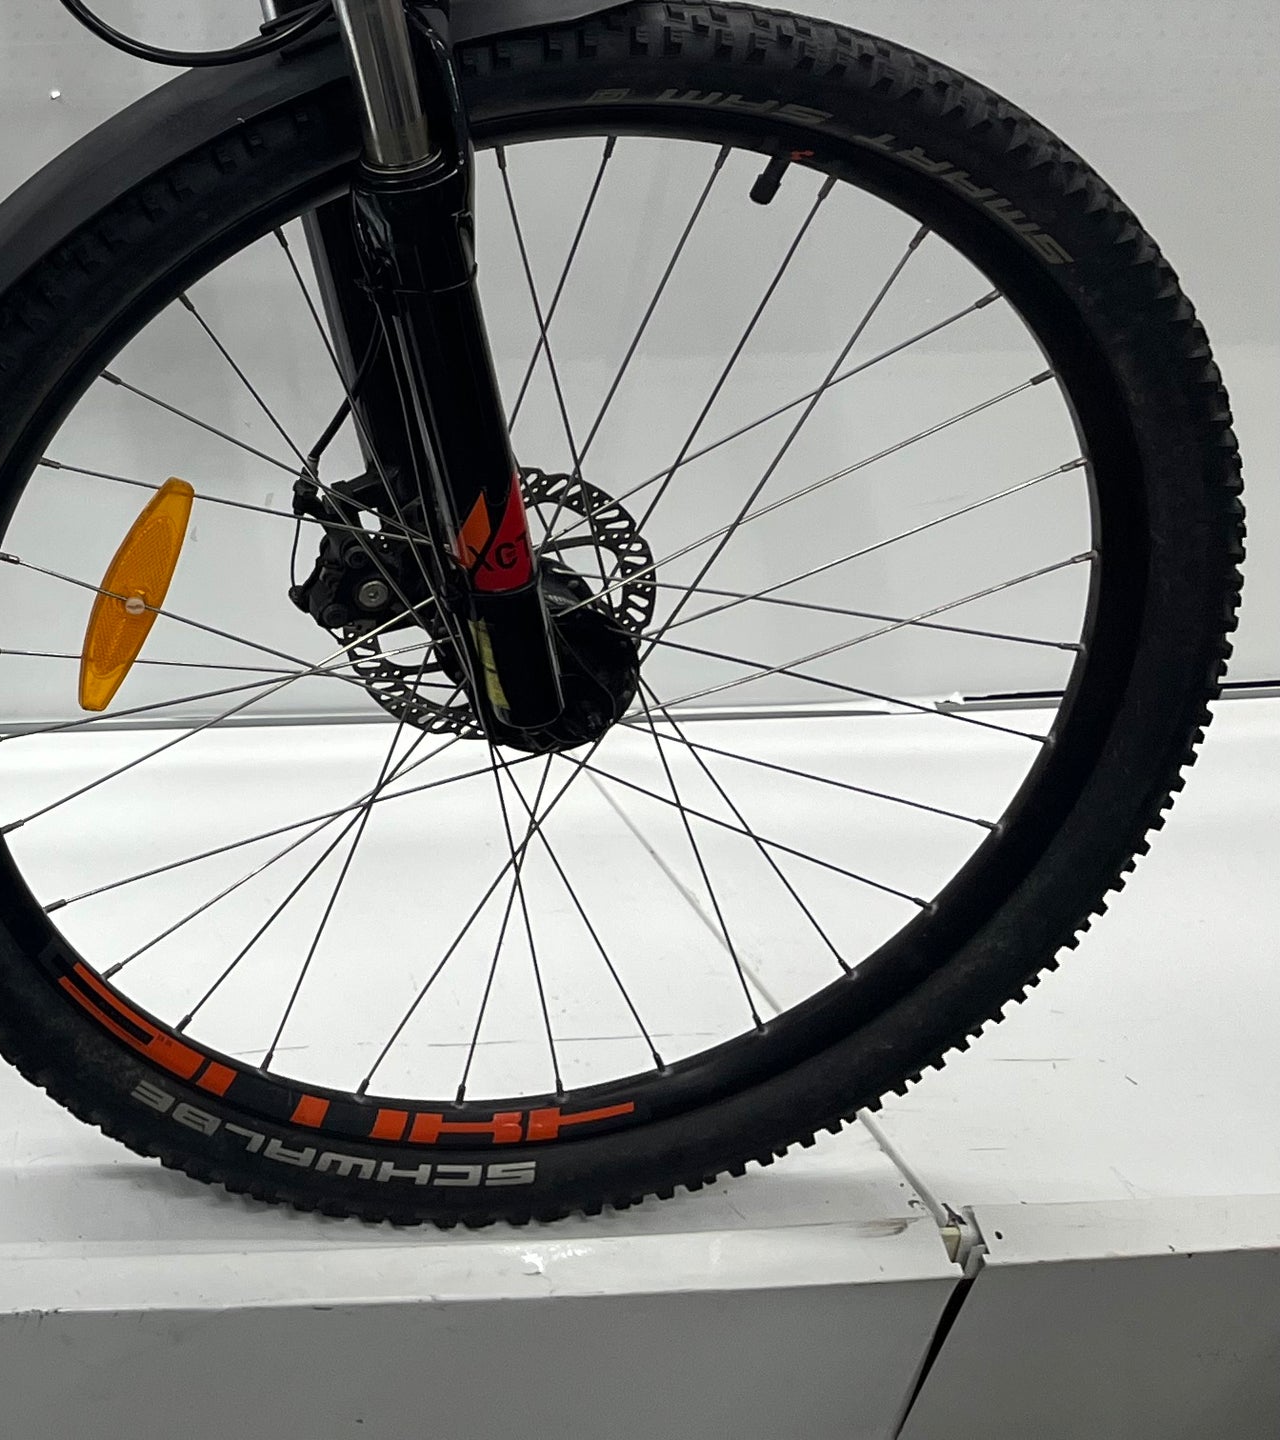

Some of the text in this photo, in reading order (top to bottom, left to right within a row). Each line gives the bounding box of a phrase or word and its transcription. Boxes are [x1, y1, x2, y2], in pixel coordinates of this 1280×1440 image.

[655, 88, 1075, 265] SMART SAM
[130, 1079, 537, 1187] SCHWALBE
